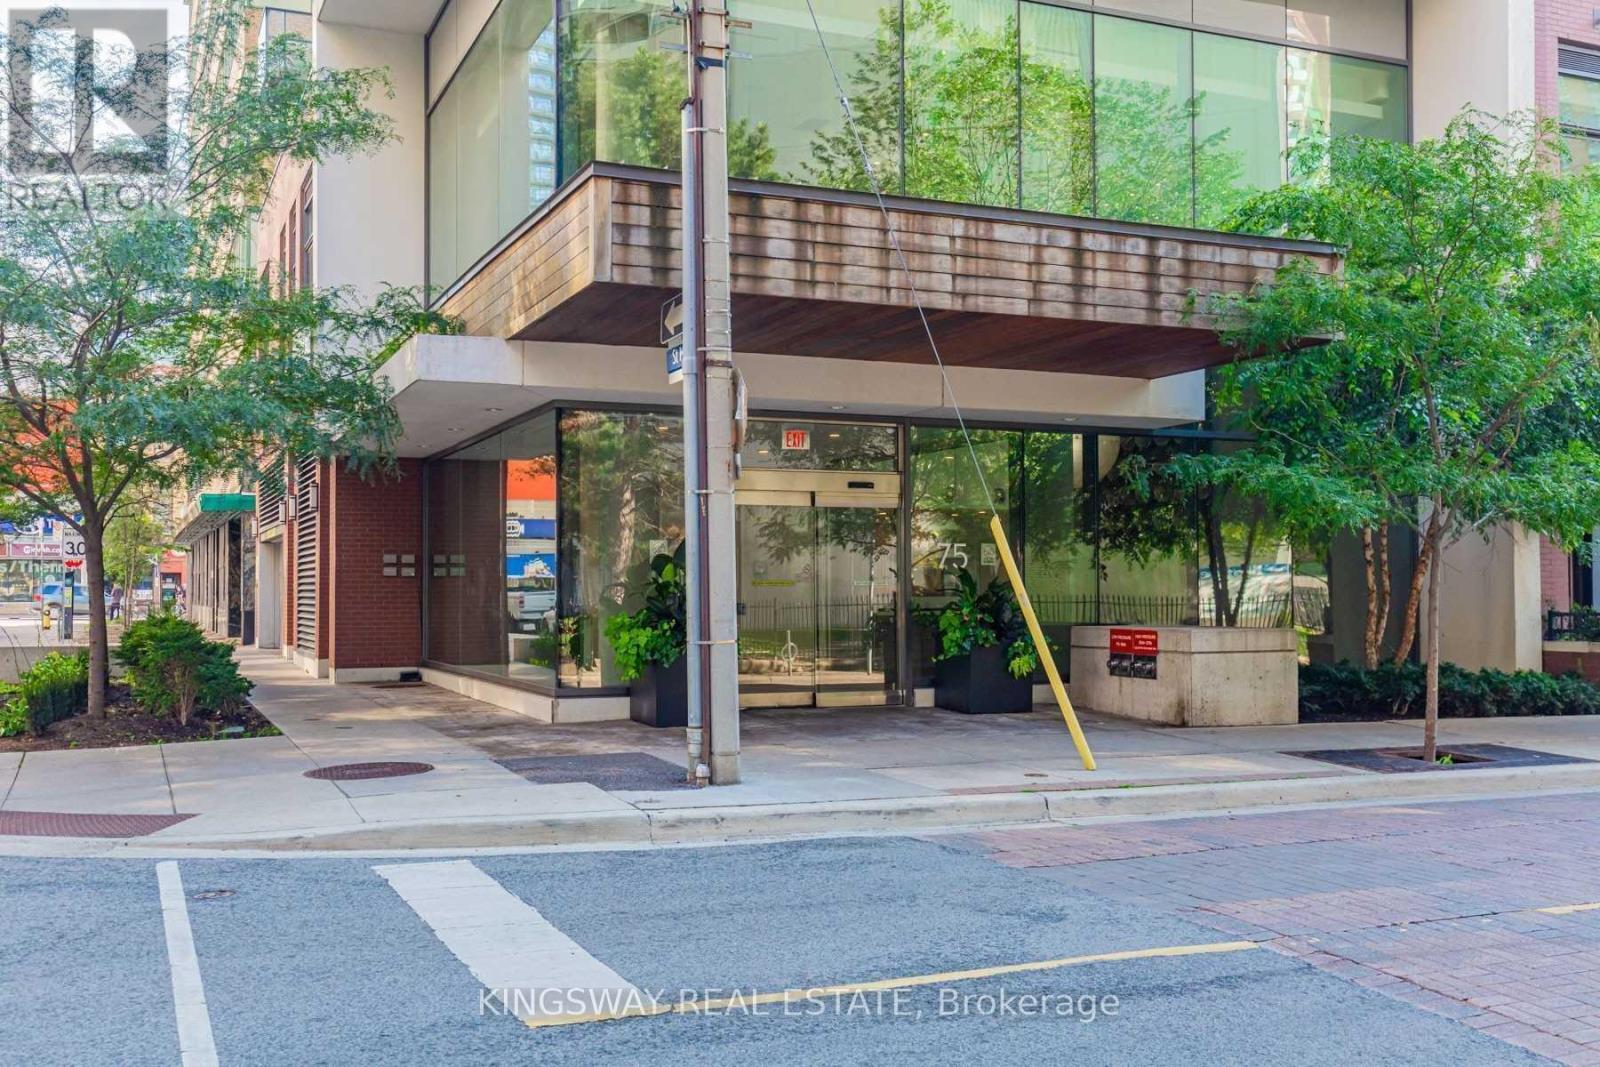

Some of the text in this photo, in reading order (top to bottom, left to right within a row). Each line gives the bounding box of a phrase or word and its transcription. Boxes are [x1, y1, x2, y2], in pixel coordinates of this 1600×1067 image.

[786, 431, 806, 448] EXIT
[65, 541, 86, 556] 30
[938, 543, 968, 568] 75
